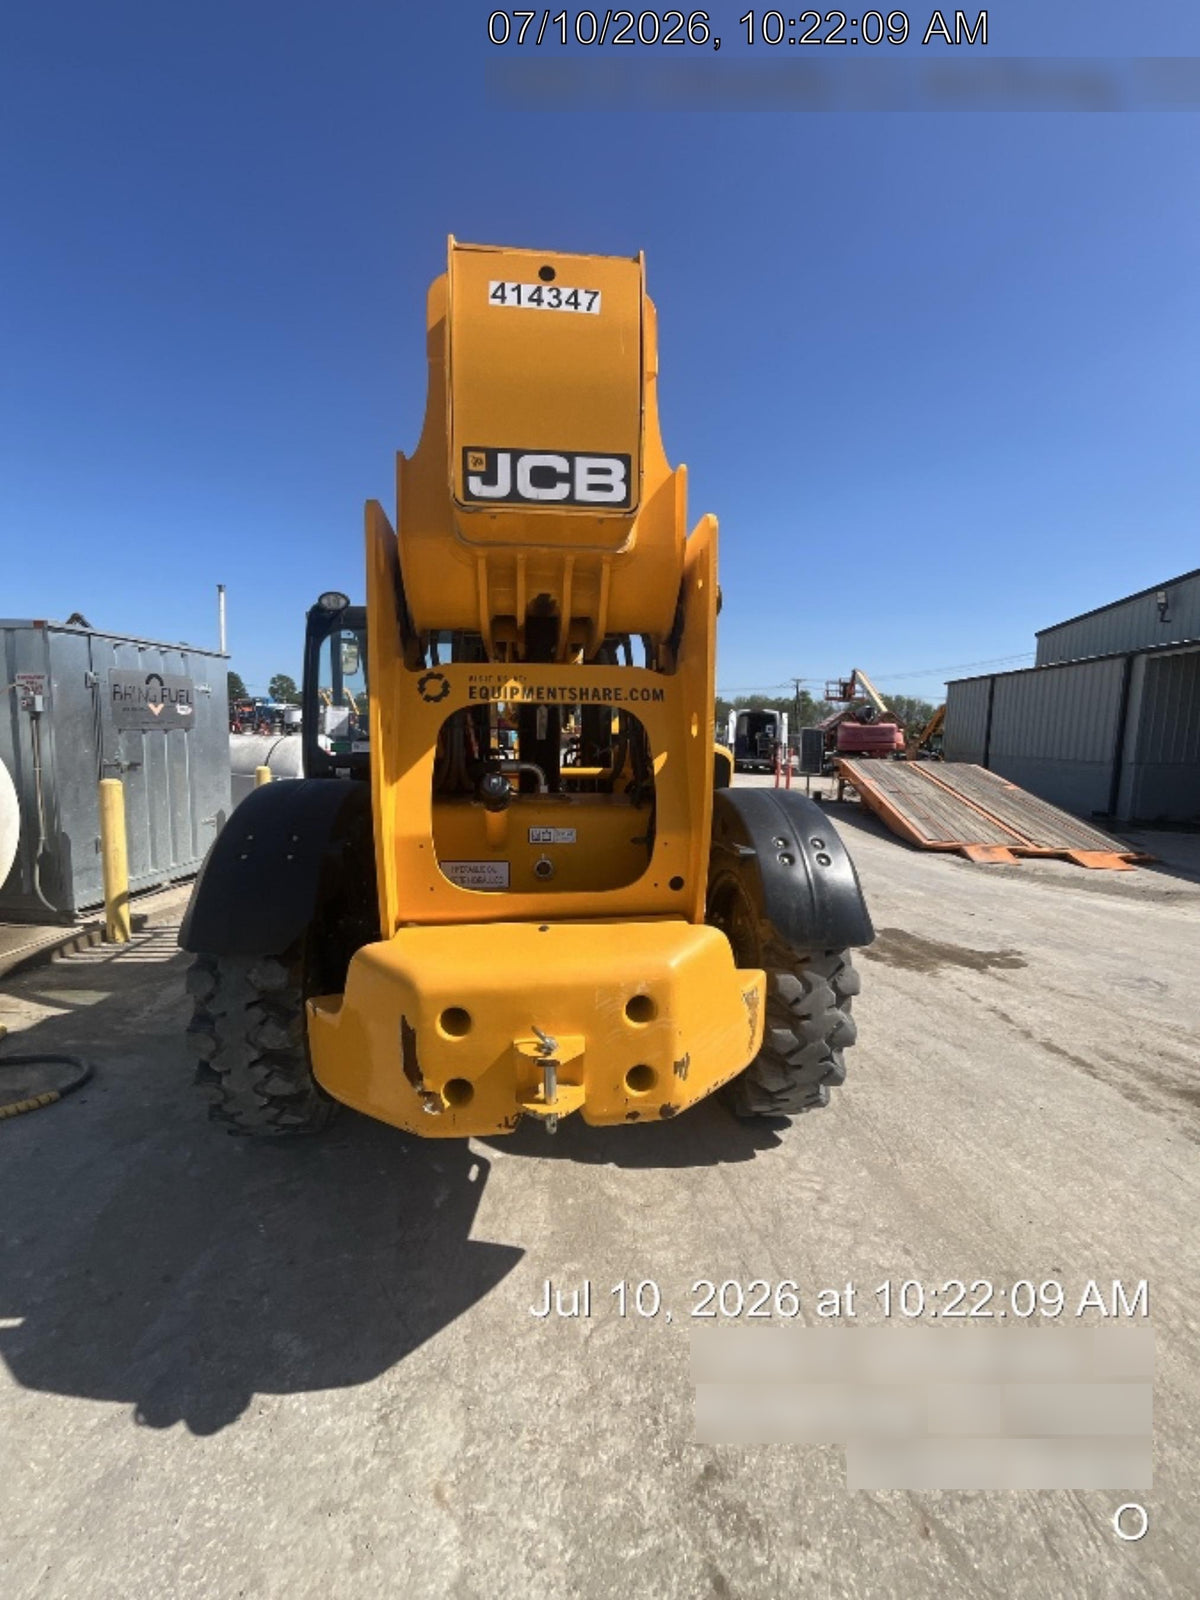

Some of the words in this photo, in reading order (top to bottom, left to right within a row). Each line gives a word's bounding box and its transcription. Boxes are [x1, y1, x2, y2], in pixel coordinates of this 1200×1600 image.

[490, 282, 600, 312] 414347
[468, 452, 627, 503] JCB
[160, 687, 194, 705] FUEL
[468, 685, 665, 702] EQUIPMENTSHARE.COM
